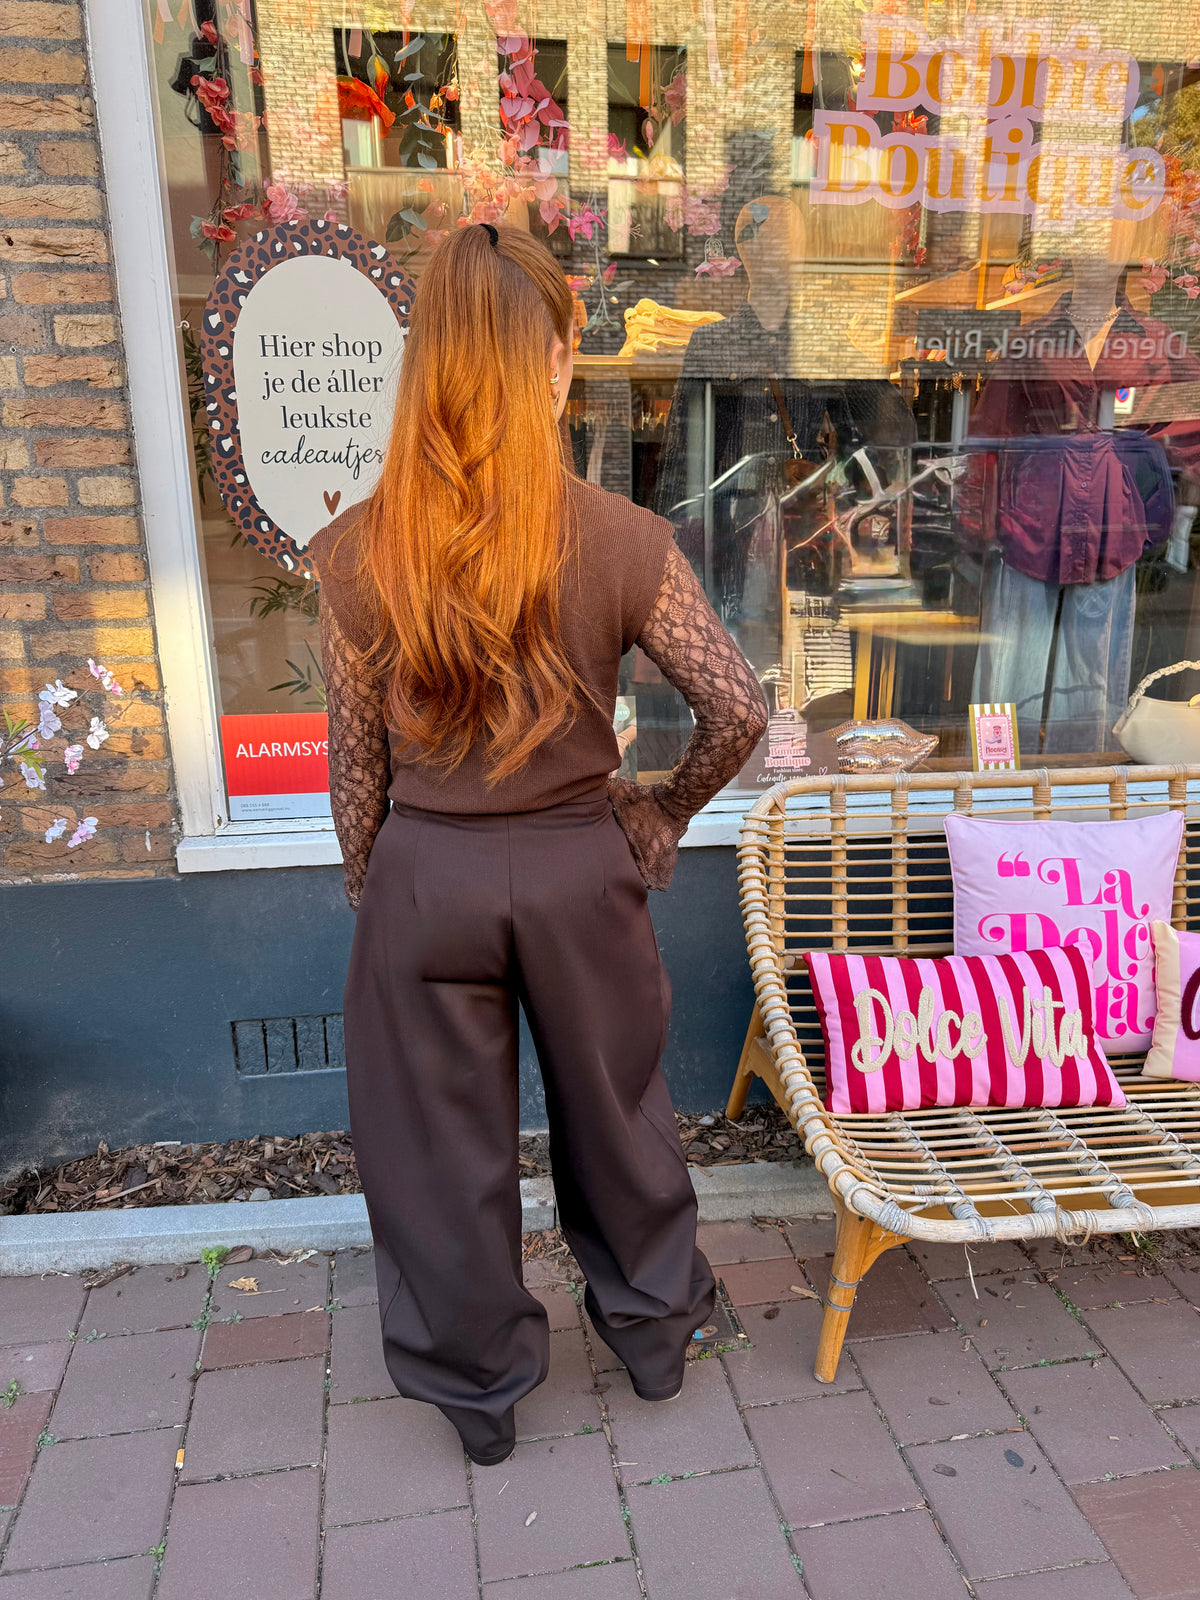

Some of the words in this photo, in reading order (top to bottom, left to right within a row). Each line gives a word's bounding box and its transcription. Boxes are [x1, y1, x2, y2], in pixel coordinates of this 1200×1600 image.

[868, 26, 1130, 115] Bobbie
[822, 122, 1156, 221] Boutique
[259, 334, 316, 358] Hier
[322, 333, 382, 363] shop
[262, 372, 285, 400] je
[291, 370, 320, 393] de
[327, 369, 384, 393] áller
[280, 405, 372, 429] leukste
[261, 436, 384, 480] cadeautjes
[765, 757, 809, 767] Boutique
[978, 909, 1150, 981] Dolc
[851, 986, 987, 1073] Dolce
[998, 985, 1087, 1069] Vita
